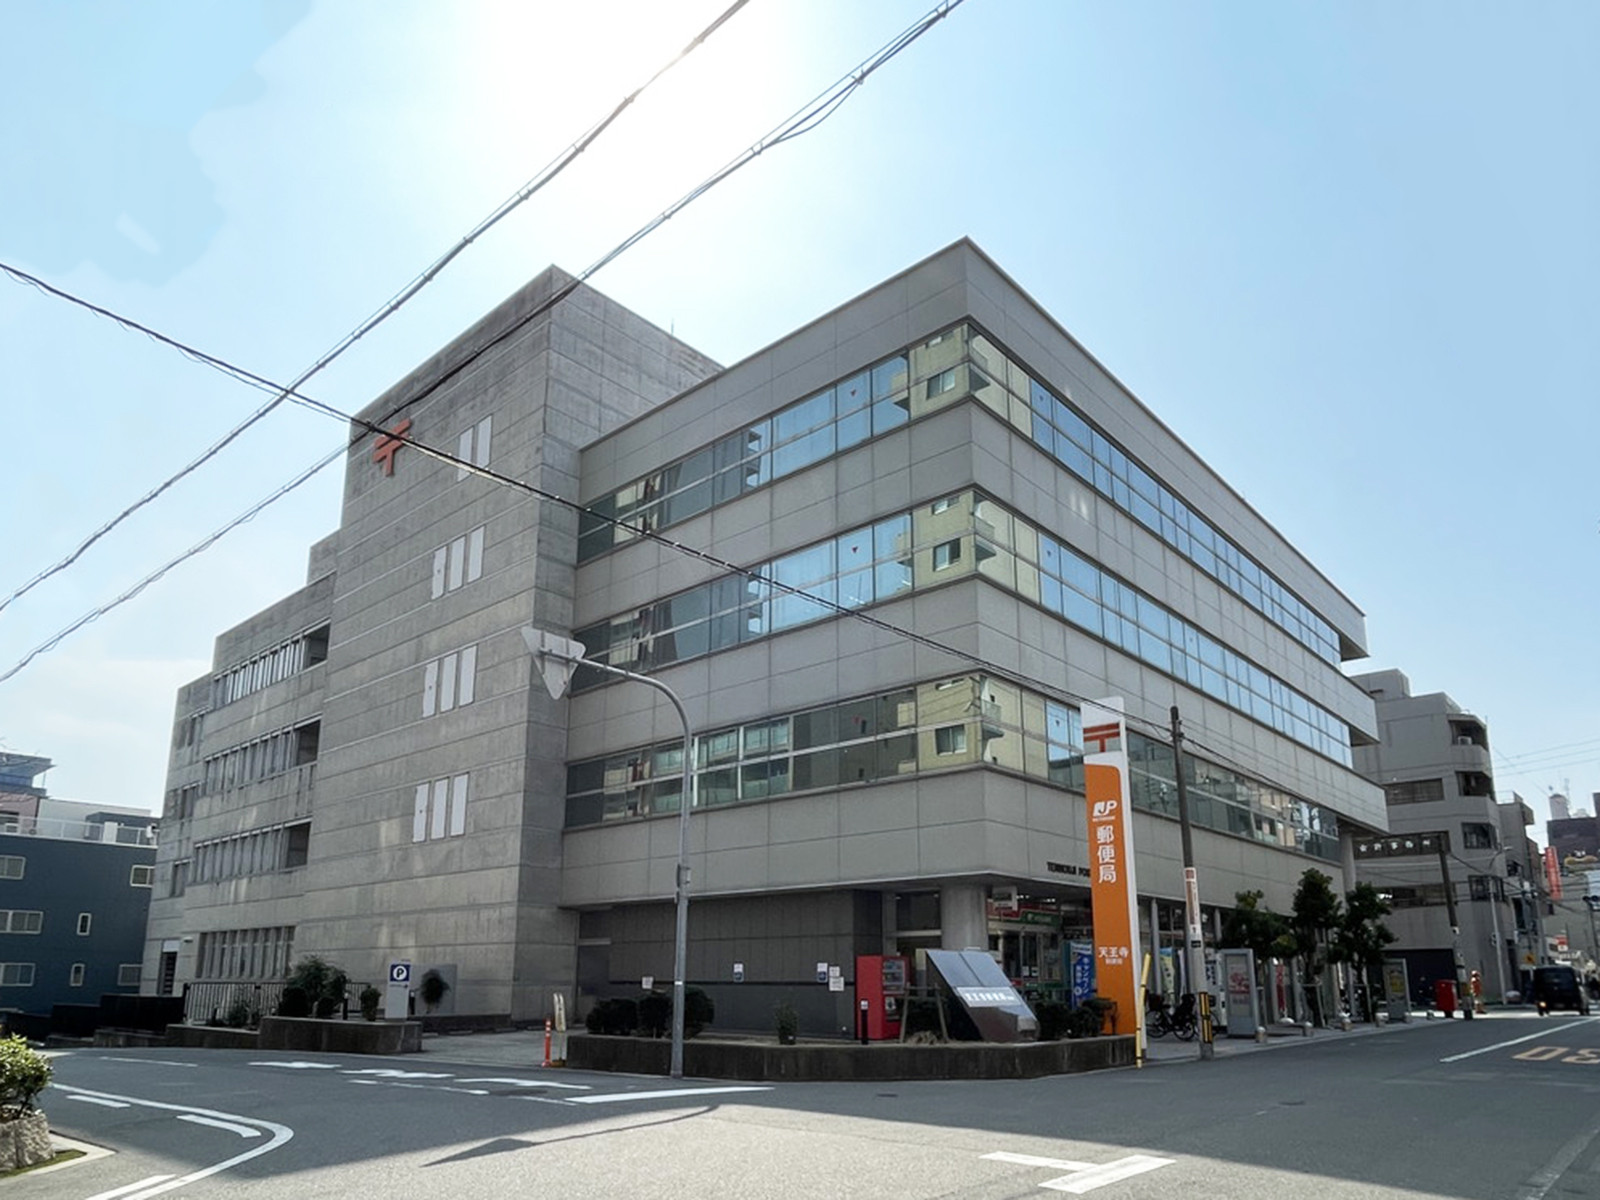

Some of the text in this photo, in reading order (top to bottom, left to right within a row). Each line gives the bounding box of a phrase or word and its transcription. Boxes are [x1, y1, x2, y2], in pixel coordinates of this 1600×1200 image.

[1096, 825, 1117, 884] 郵便局
[1098, 946, 1129, 958] 天王寺
[396, 967, 405, 978] P
